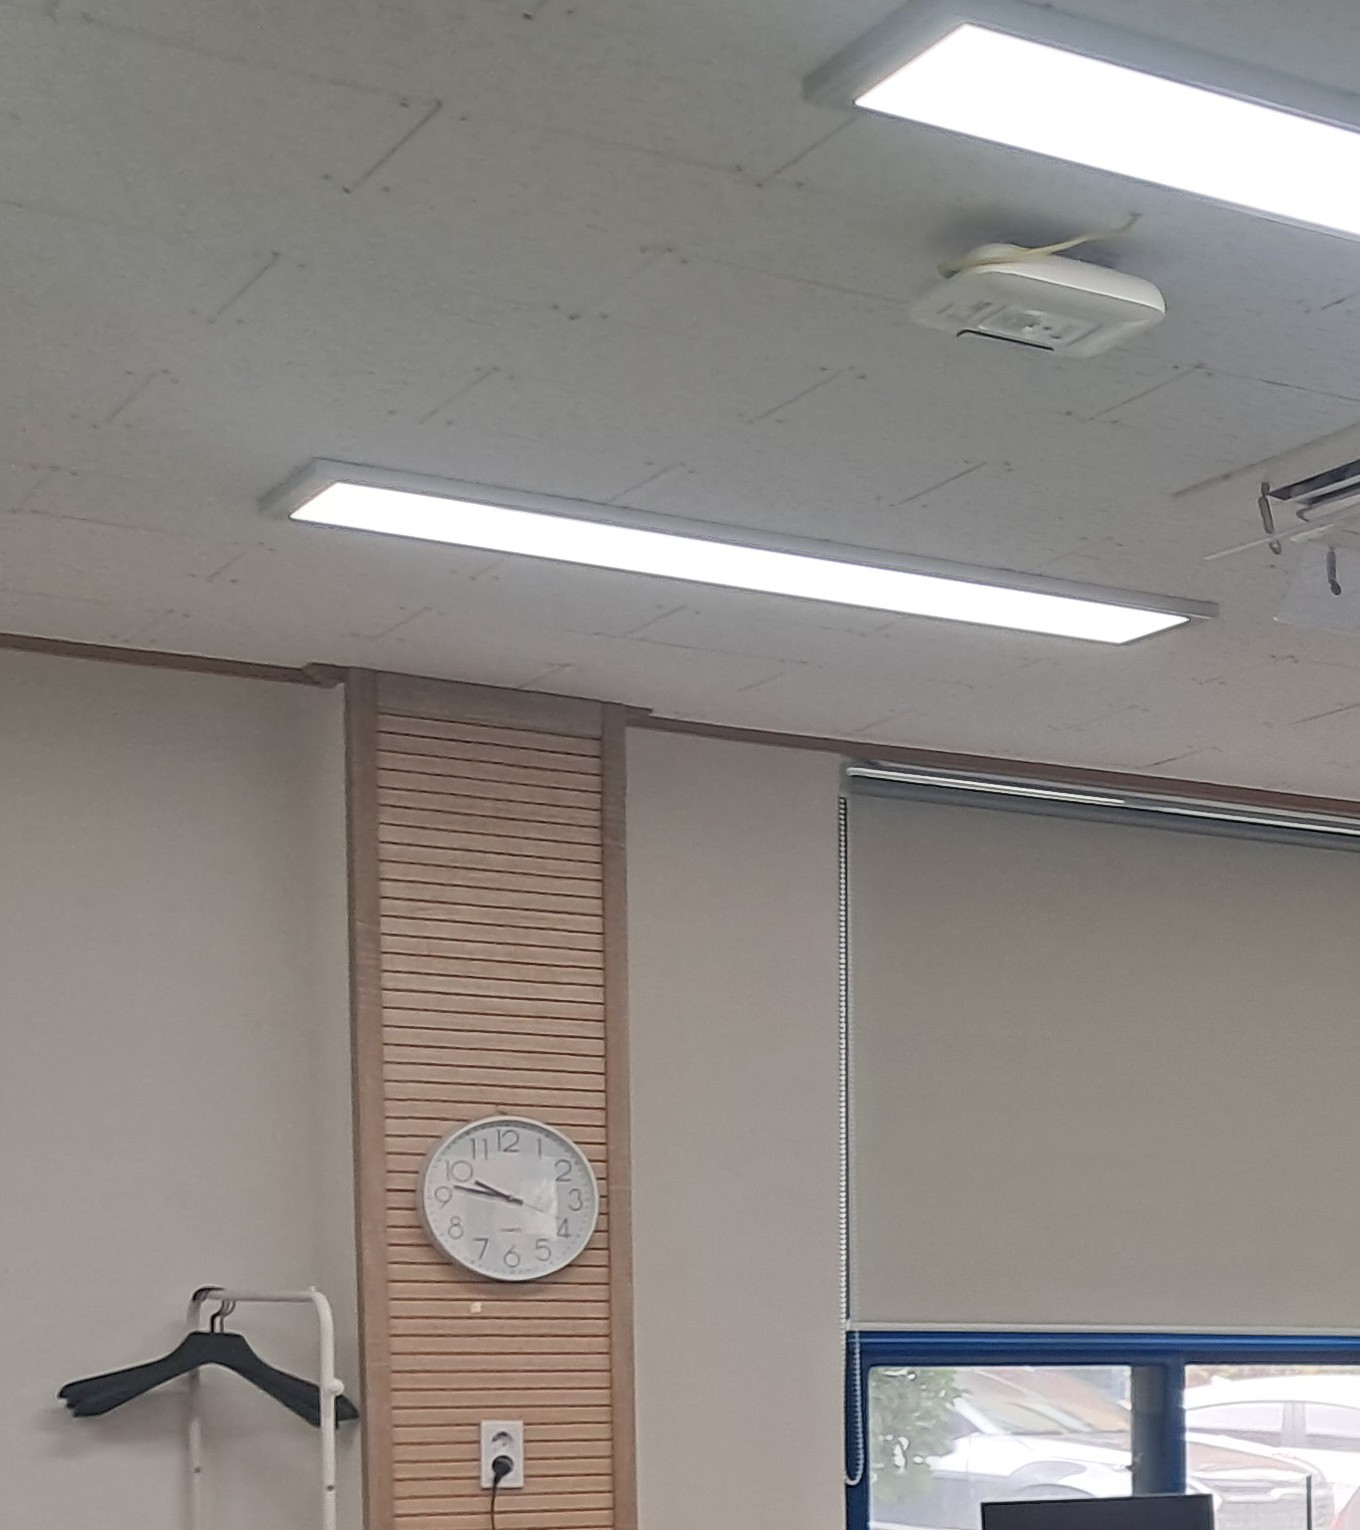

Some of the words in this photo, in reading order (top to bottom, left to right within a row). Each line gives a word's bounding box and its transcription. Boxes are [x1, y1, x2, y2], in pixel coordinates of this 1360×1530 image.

[470, 1138, 488, 1160] 11
[497, 1129, 520, 1153] 12
[536, 1138, 543, 1158] 1
[445, 1159, 474, 1183] 10
[554, 1159, 572, 1182] 2
[434, 1185, 453, 1209] 9
[568, 1188, 584, 1211] 3
[447, 1215, 464, 1240] 8
[557, 1218, 571, 1239] 4
[472, 1238, 489, 1261] 7
[503, 1246, 521, 1269] 6
[535, 1239, 552, 1262] 5
